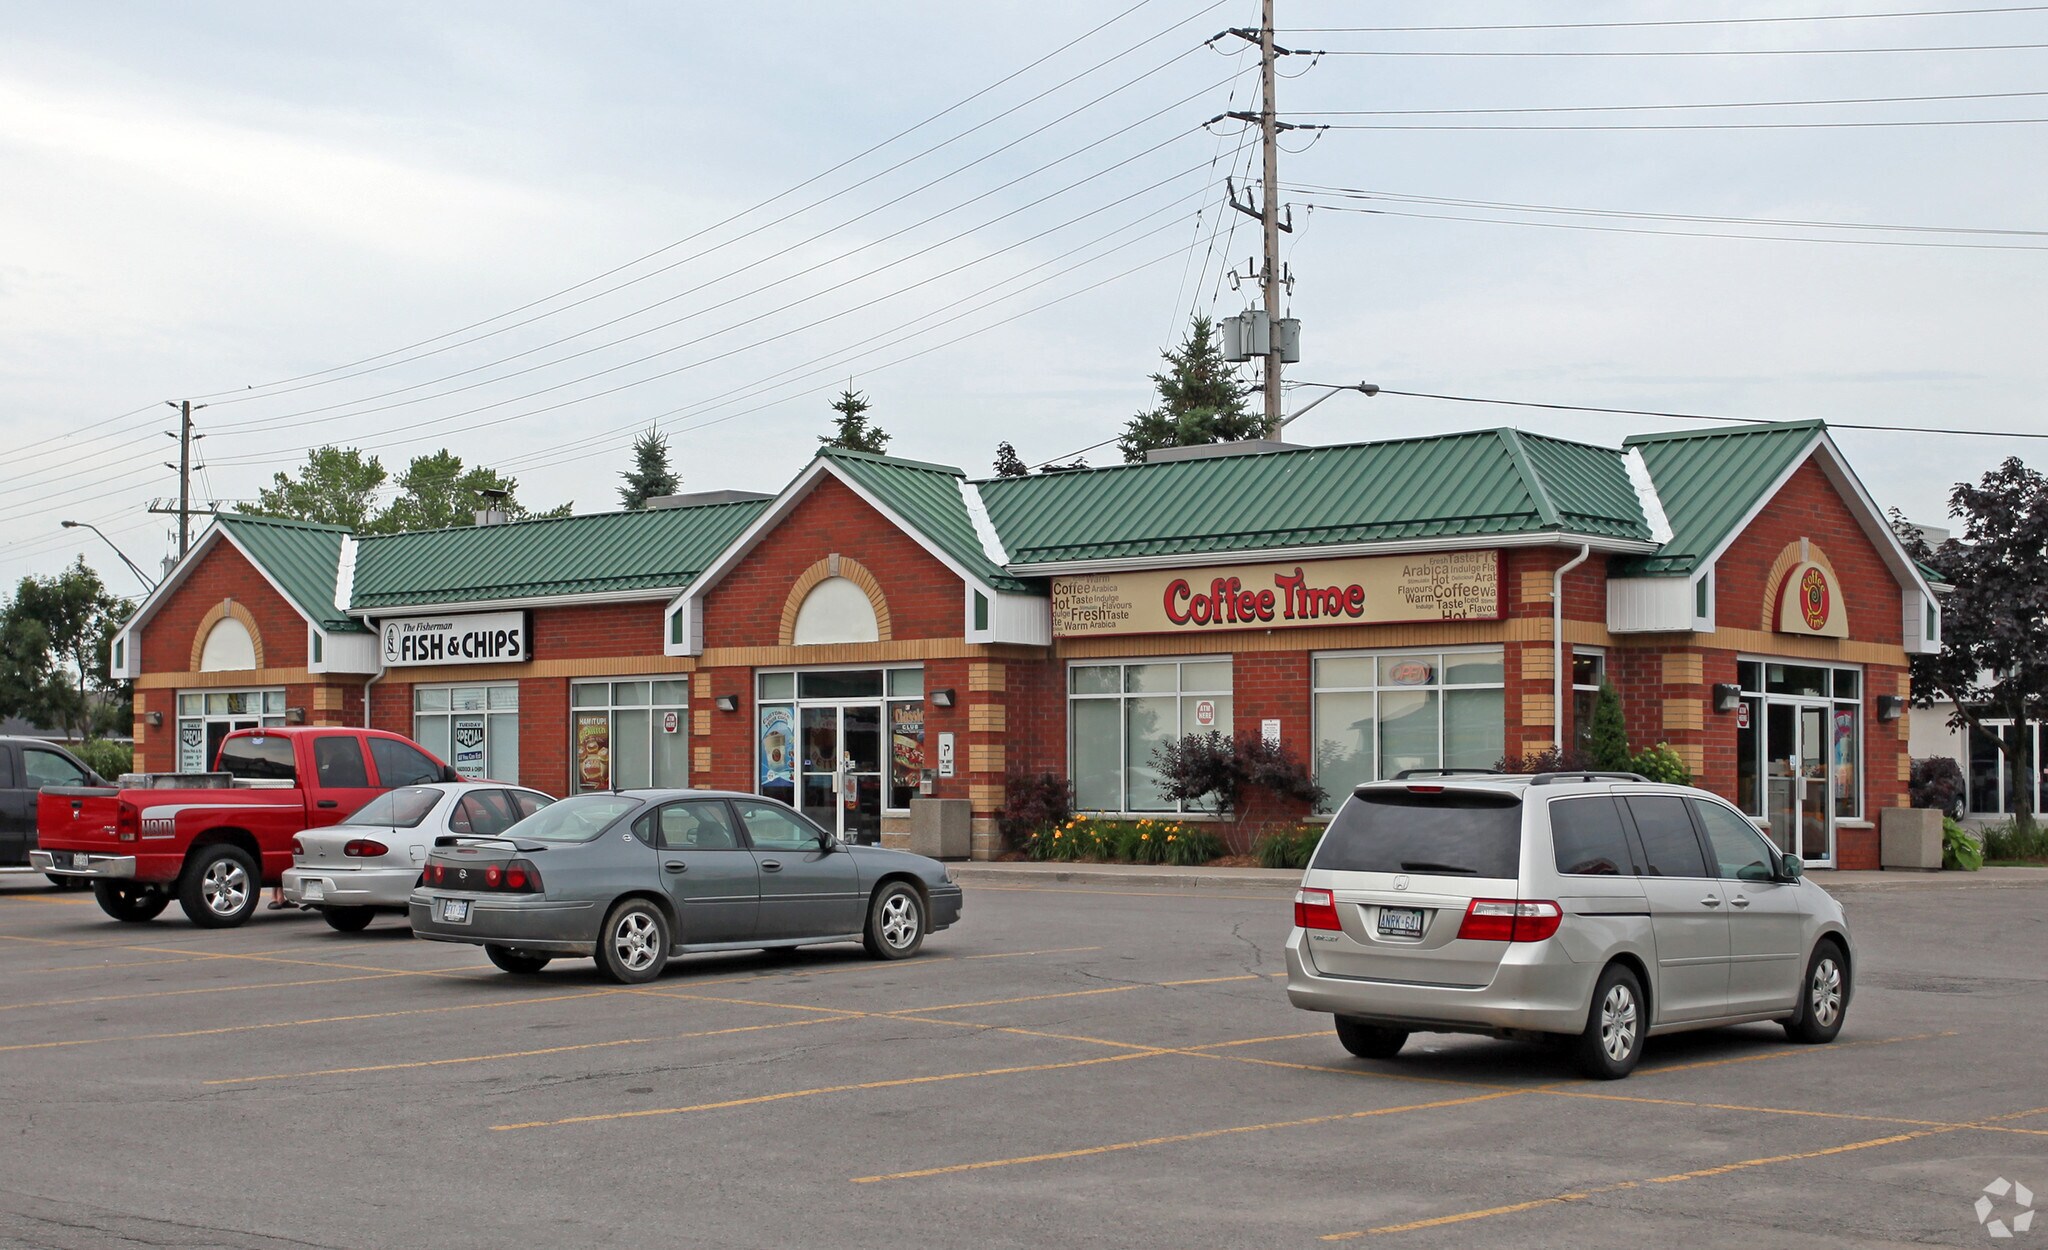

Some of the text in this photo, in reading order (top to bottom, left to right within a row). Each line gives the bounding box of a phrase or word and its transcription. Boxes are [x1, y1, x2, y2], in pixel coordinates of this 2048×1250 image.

[1448, 553, 1474, 563] Taste
[1403, 564, 1449, 577] Arabica
[1451, 565, 1481, 574] Indulge
[1432, 574, 1449, 585] Hot
[1803, 570, 1825, 591] Coffee
[1053, 582, 1091, 595] Coffee
[1398, 585, 1433, 594] Flavours
[1433, 583, 1479, 598] Coffee
[1071, 595, 1093, 604] Taste
[1094, 594, 1119, 603] Indulge
[1163, 566, 1365, 626] Coffee Time
[1405, 594, 1434, 603] Warm
[1464, 596, 1479, 604] Iced
[1102, 601, 1132, 610] Flavours
[1436, 599, 1463, 609] Taste
[1071, 607, 1106, 621] Fresh
[1106, 610, 1129, 619] Taste
[1807, 608, 1824, 628] Time
[403, 622, 453, 632] The Fisherman
[1064, 621, 1088, 630] Warm
[401, 629, 520, 661] FISH & CHIPS
[1391, 665, 1430, 681] OPEN
[183, 730, 202, 746] SPECIA
[457, 729, 482, 746] SPECIAL
